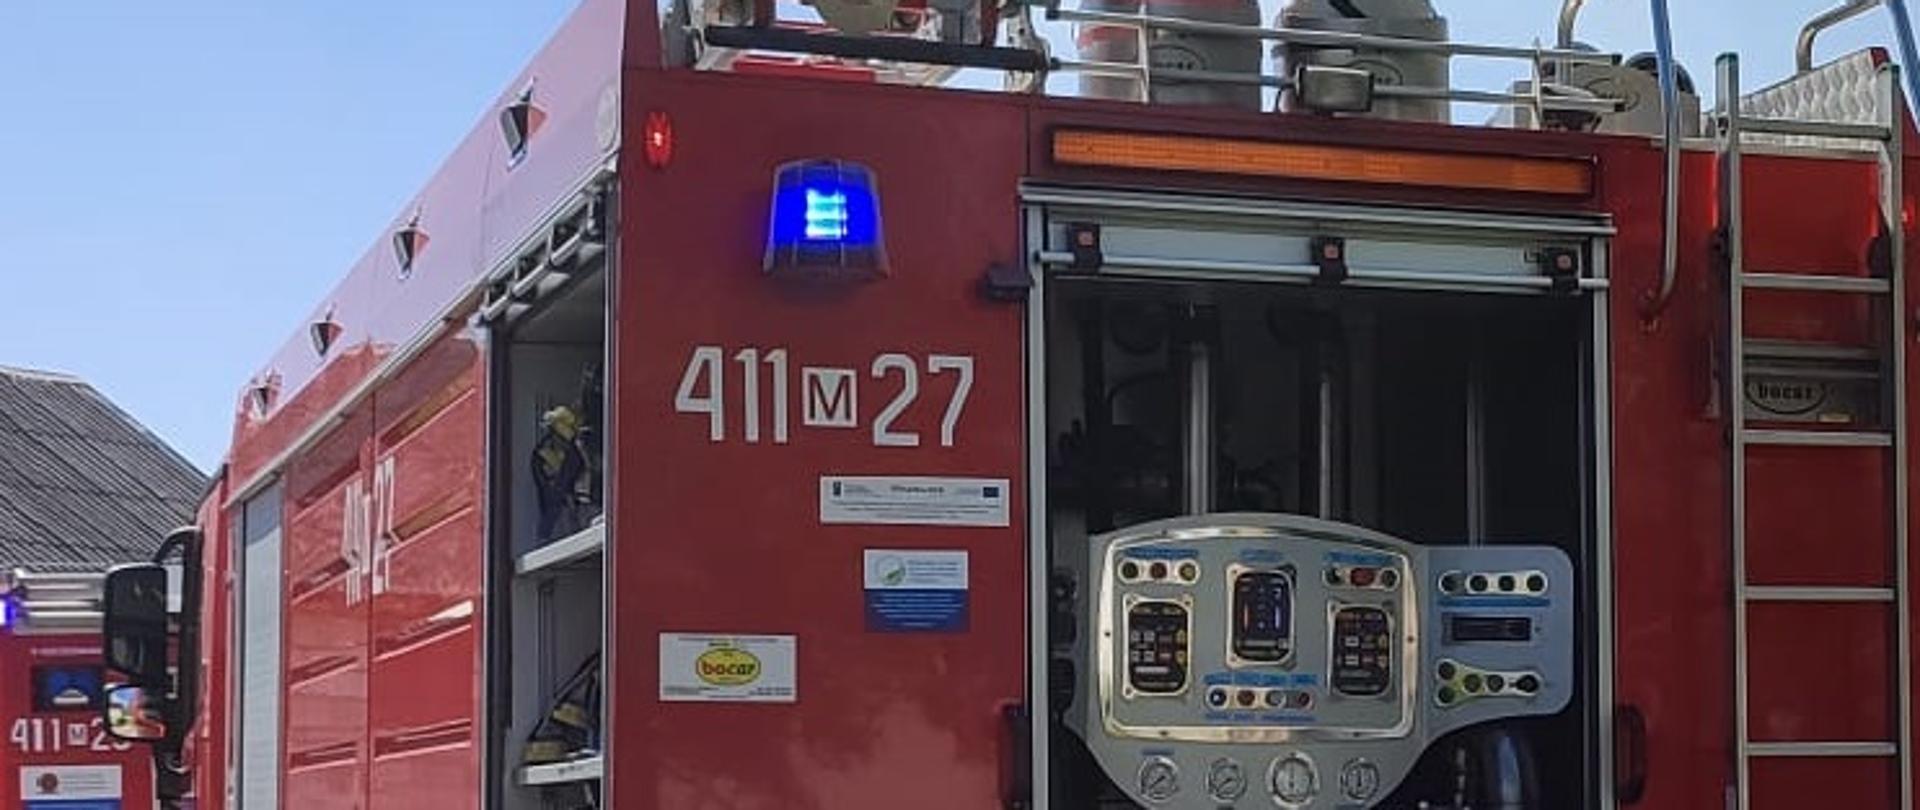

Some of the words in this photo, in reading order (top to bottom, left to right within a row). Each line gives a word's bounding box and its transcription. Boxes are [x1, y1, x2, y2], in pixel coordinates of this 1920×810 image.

[674, 346, 788, 443] 411
[808, 374, 853, 421] M
[871, 353, 975, 447] 27
[702, 660, 756, 676] bocar
[10, 717, 61, 752] 411
